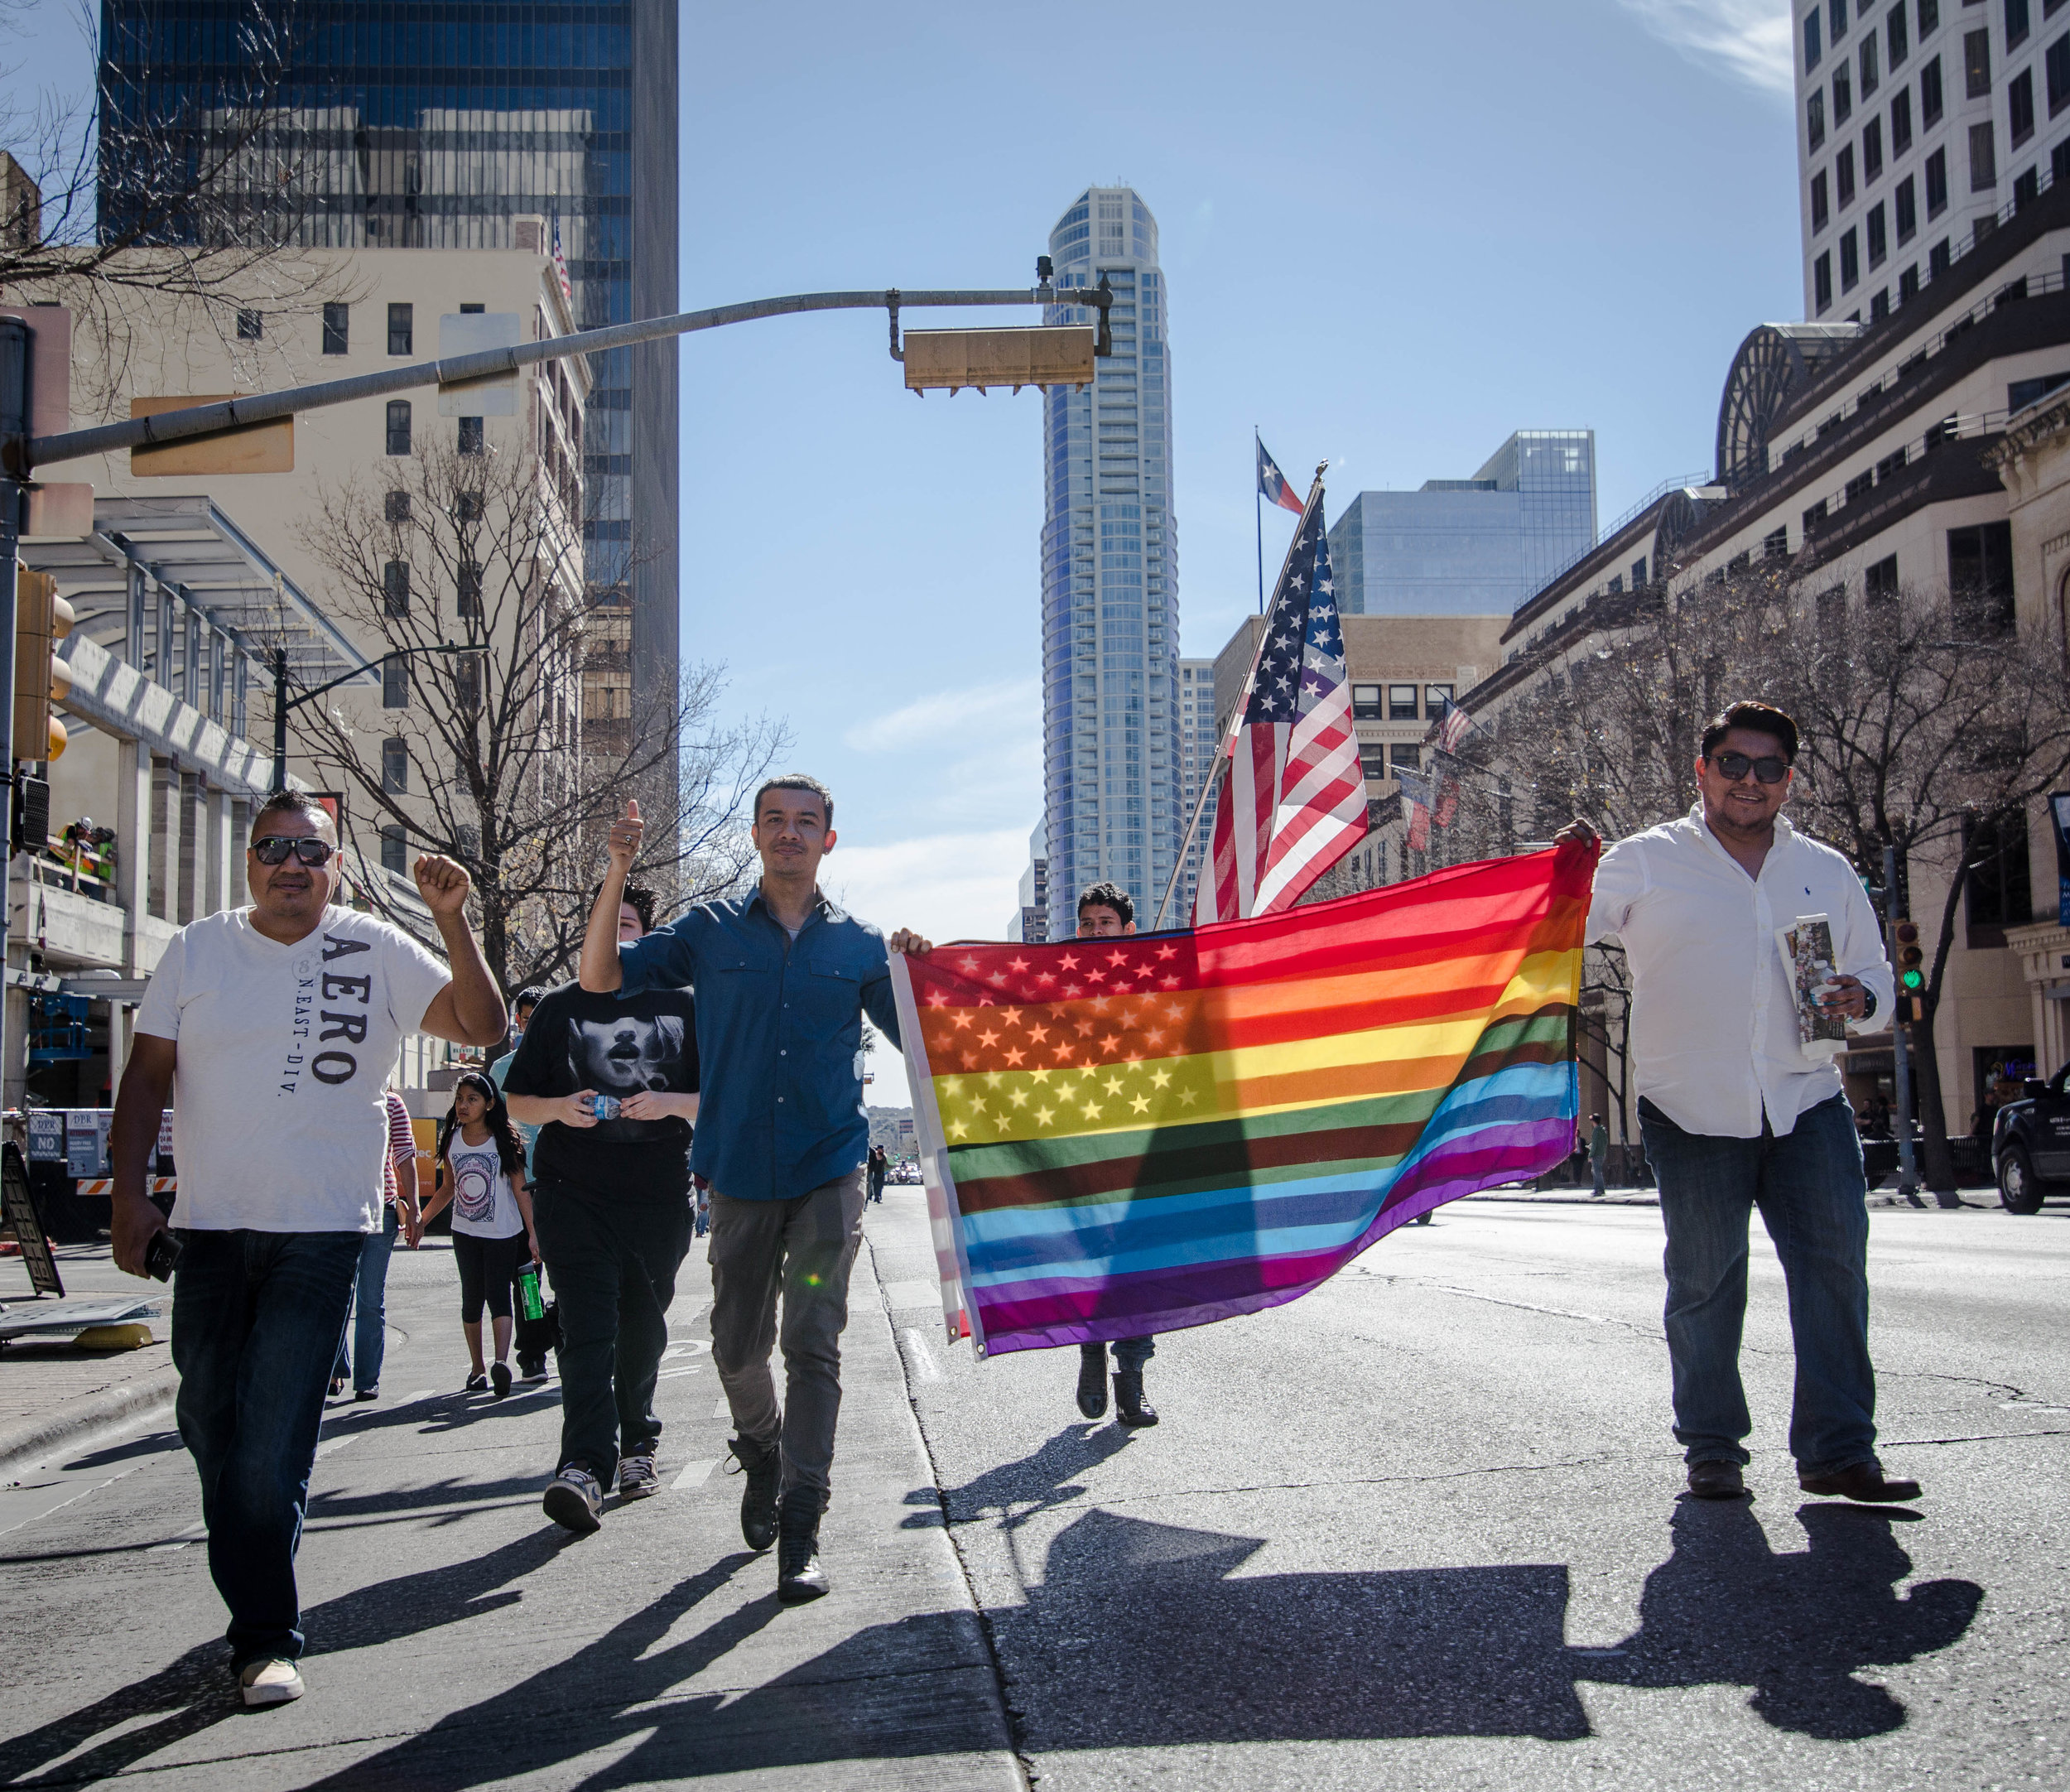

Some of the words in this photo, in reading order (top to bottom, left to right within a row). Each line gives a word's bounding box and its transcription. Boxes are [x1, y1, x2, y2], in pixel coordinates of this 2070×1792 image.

[310, 932, 372, 1085] AERO
[37, 1120, 55, 1130] DPR
[74, 1115, 92, 1125] DPR
[37, 1137, 55, 1149] NO
